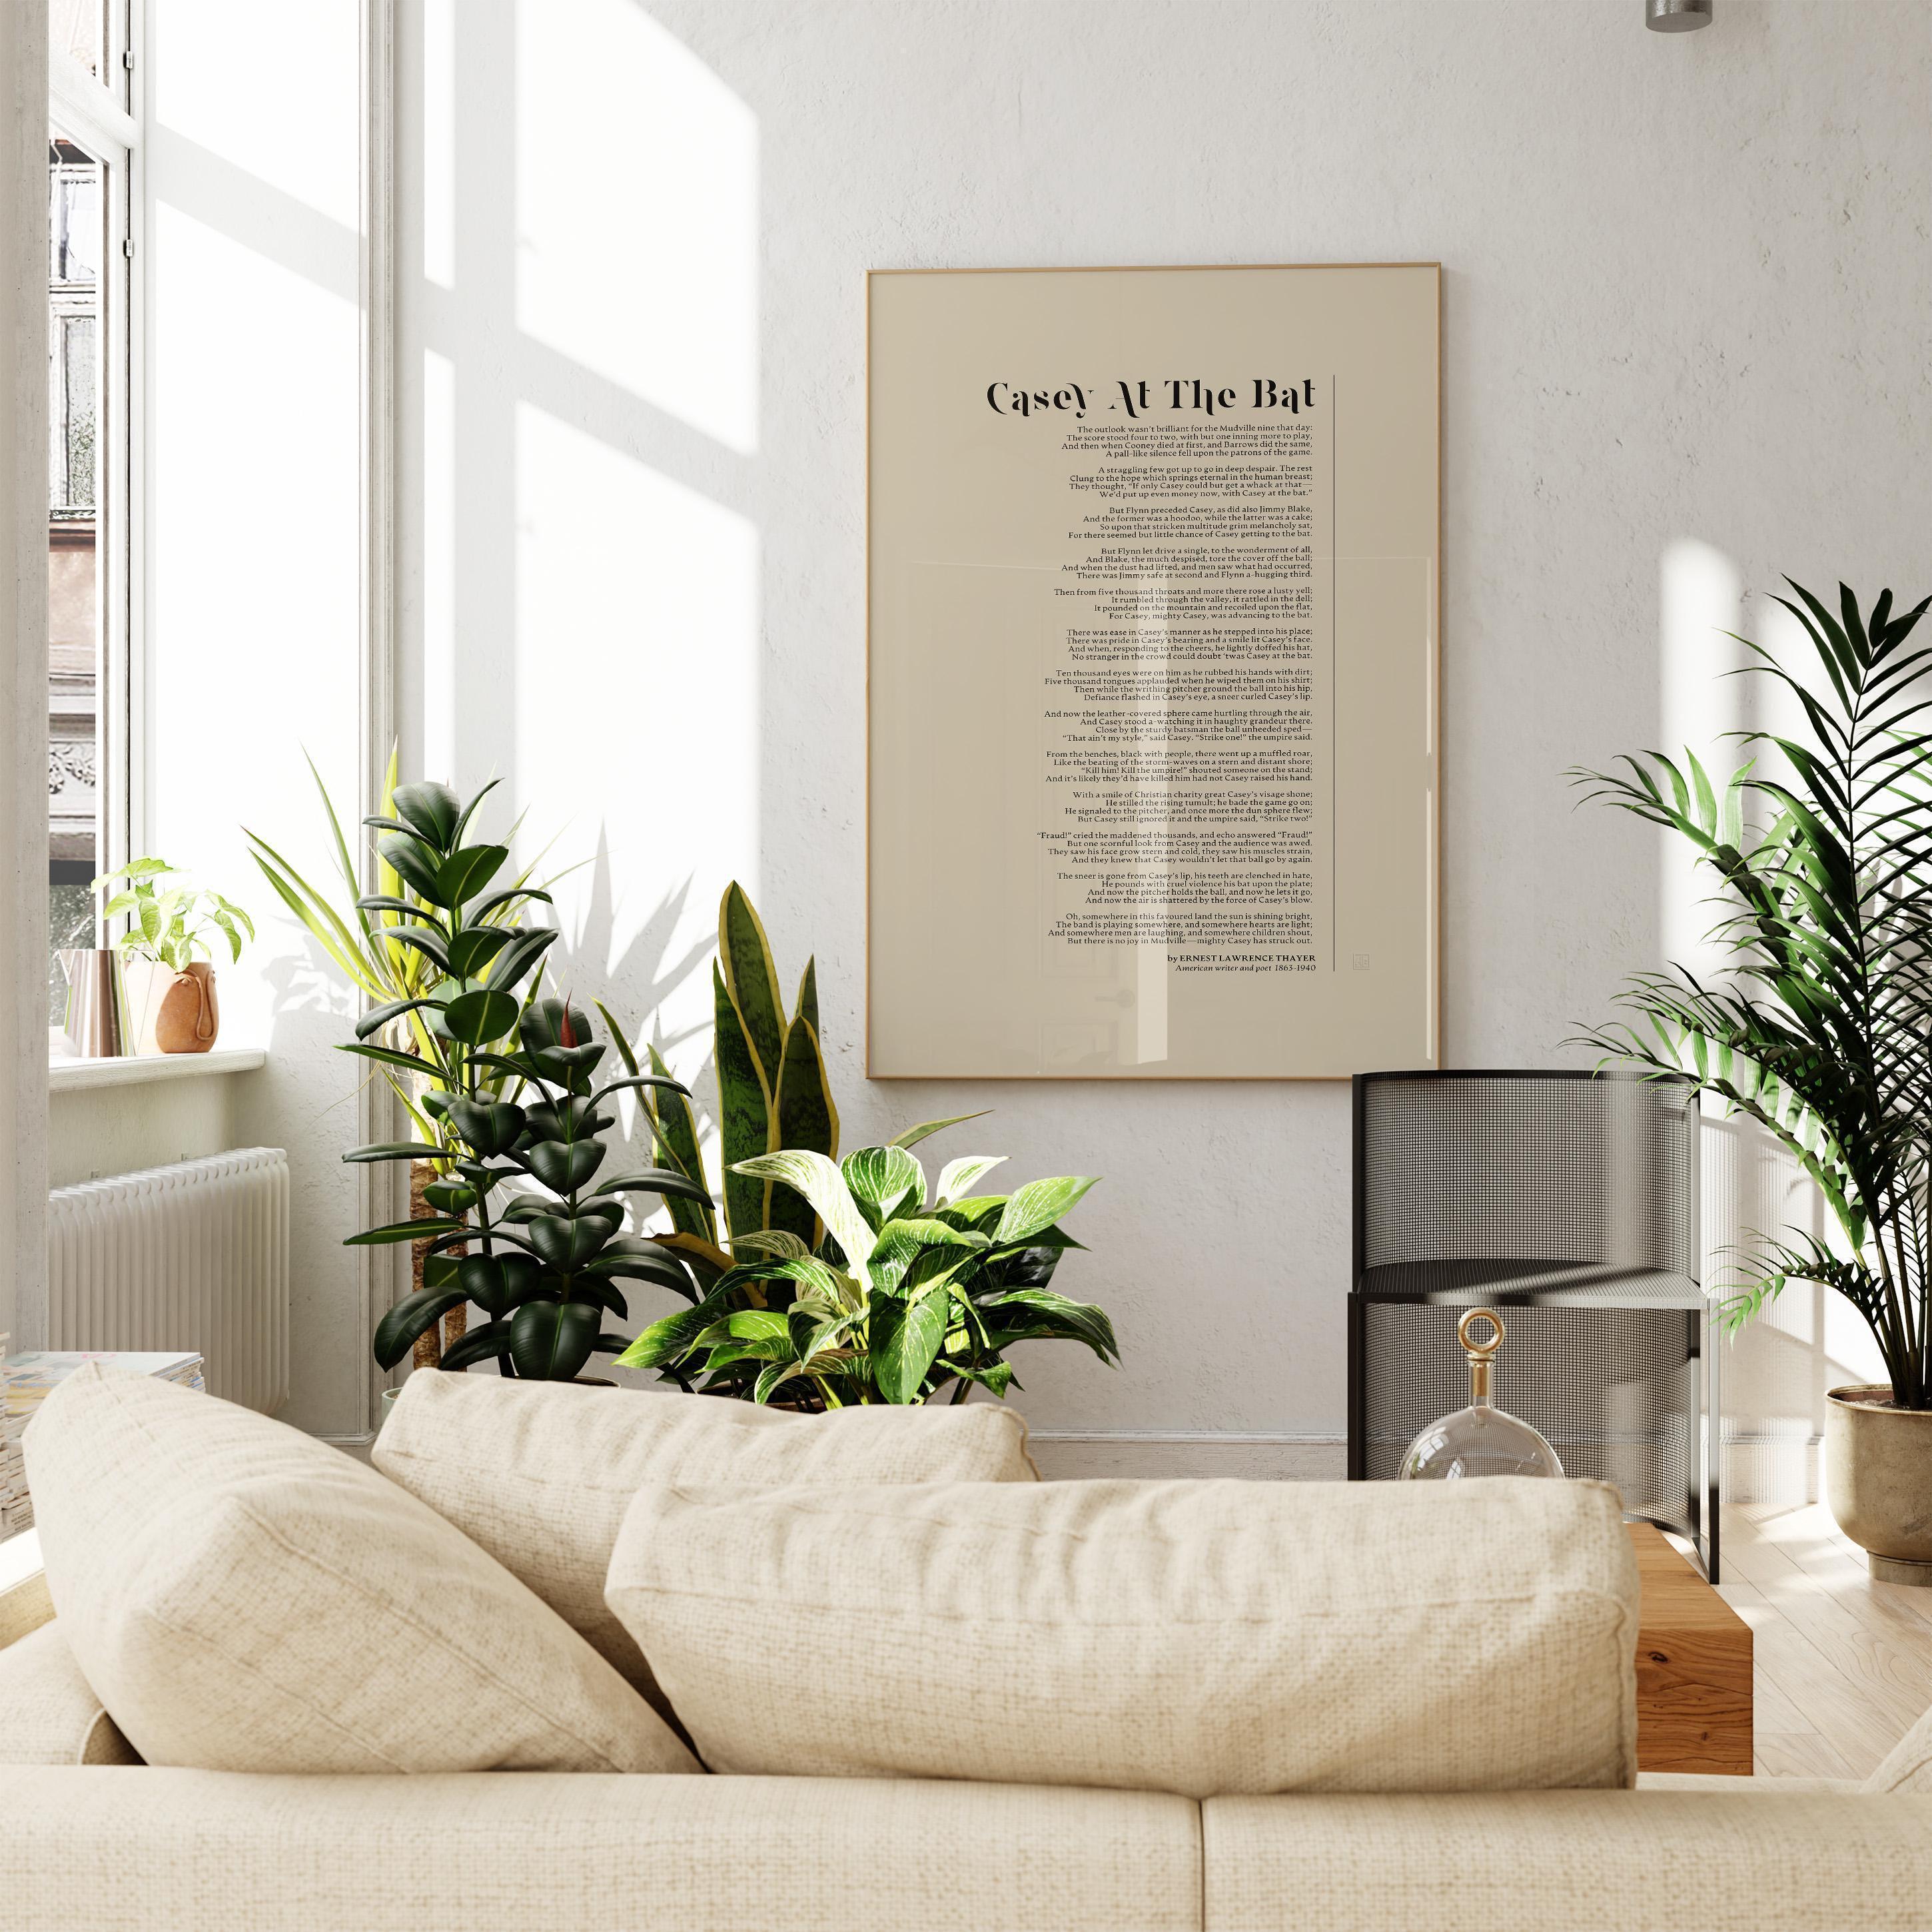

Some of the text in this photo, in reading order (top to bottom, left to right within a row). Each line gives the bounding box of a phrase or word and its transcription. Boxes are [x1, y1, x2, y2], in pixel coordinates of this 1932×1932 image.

[987, 378, 1316, 419] Casey At The Bat
[1115, 450, 1147, 458] pall-like
[1070, 474, 1094, 484] Clung
[1121, 474, 1141, 483] hope
[1169, 474, 1198, 482] springs
[1284, 472, 1312, 481] breast;
[1126, 506, 1149, 516] Flynn
[1151, 506, 1187, 515] preceded
[1189, 506, 1215, 515] Casey,
[1259, 506, 1285, 514] Jimmy
[1119, 571, 1145, 580] Jimmy
[1220, 570, 1244, 579] Flynn
[1246, 570, 1288, 579] a-hugging
[1156, 596, 1189, 604] through
[1205, 595, 1231, 604] valley,
[1113, 644, 1158, 653] responding
[1226, 644, 1253, 652] lightly
[1137, 677, 1179, 686] applauded
[1216, 677, 1241, 686] wiped
[1099, 718, 1123, 727] Casey
[1149, 718, 1195, 726] a-watching
[1214, 718, 1248, 726] haughty
[1250, 717, 1287, 726] grandeur
[1089, 758, 1118, 767] beating
[1161, 799, 1183, 807] rising
[1185, 798, 1215, 807] tumult;
[1176, 839, 1199, 848] Casey
[1115, 879, 1145, 889] pounds
[1290, 879, 1312, 888] plate;
[1103, 921, 1134, 929] playing
[1291, 921, 1312, 929] light;
[1167, 955, 1178, 964] by
